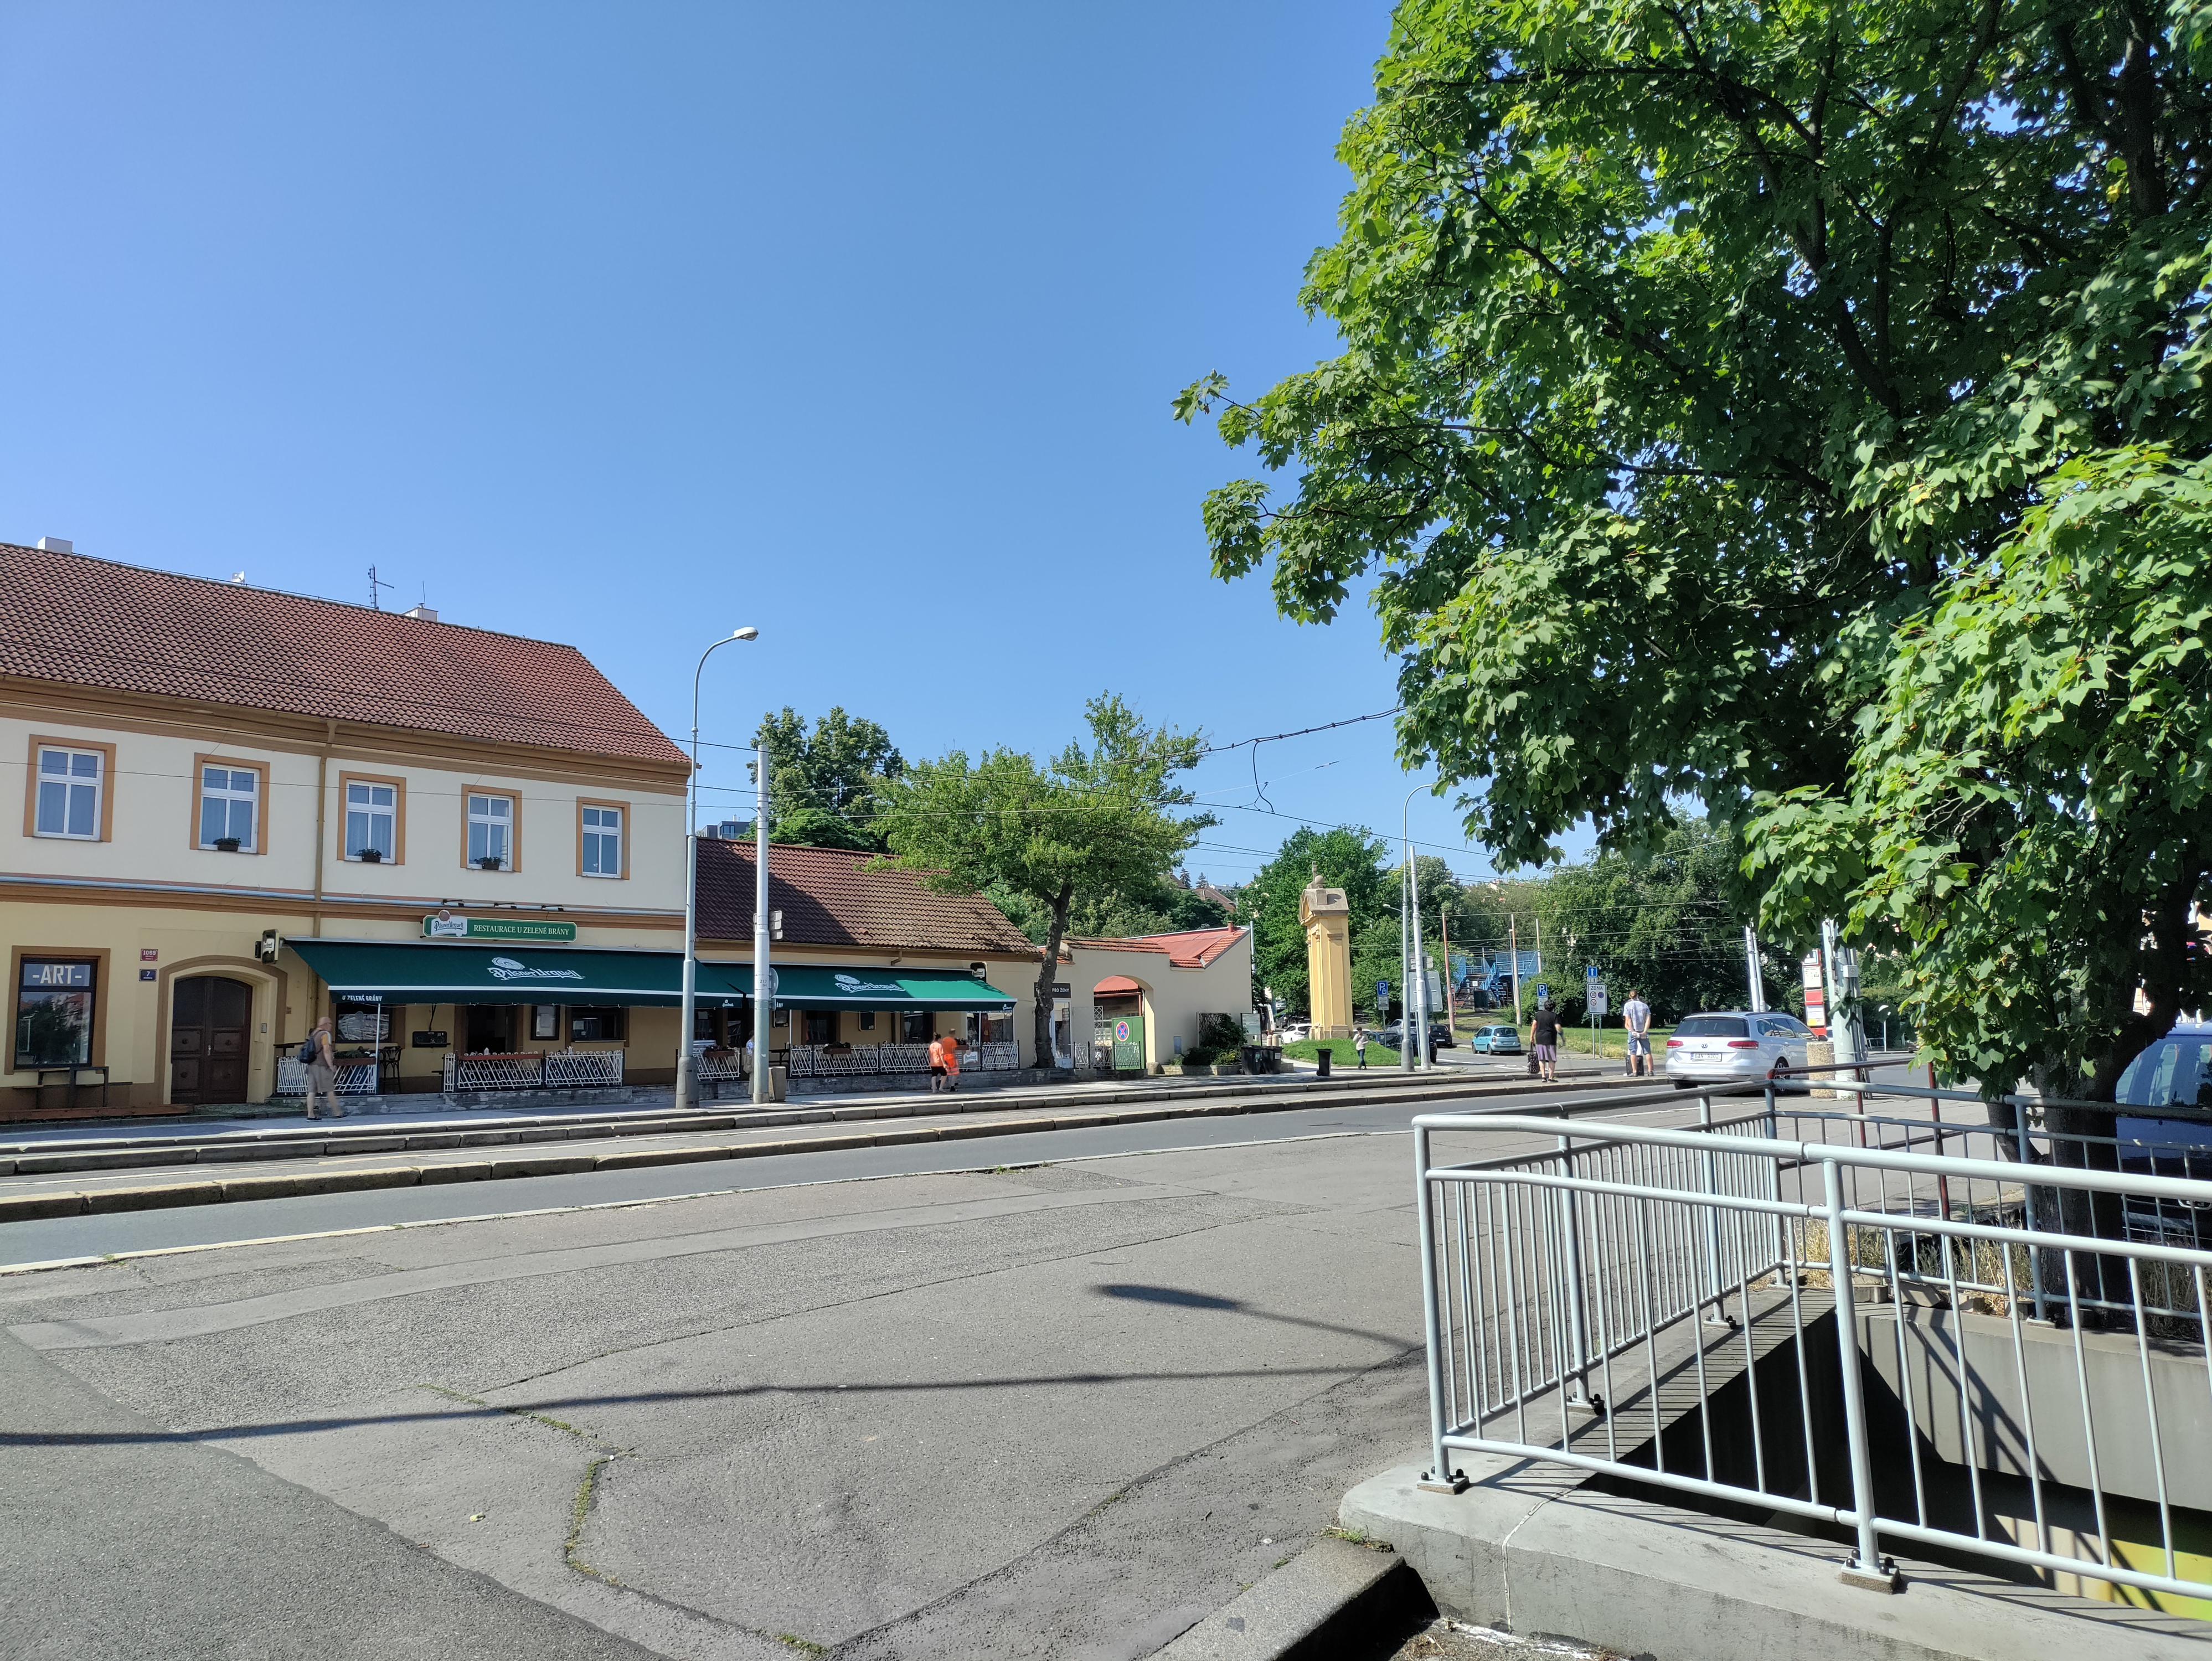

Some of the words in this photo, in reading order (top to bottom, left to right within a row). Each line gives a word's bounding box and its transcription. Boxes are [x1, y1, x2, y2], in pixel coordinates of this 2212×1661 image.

[473, 925, 516, 933] RESTAURACE
[548, 927, 569, 935] BRÁNY
[487, 967, 536, 981] Pilsner
[529, 968, 583, 979] Urquell
[1379, 982, 1385, 991] P
